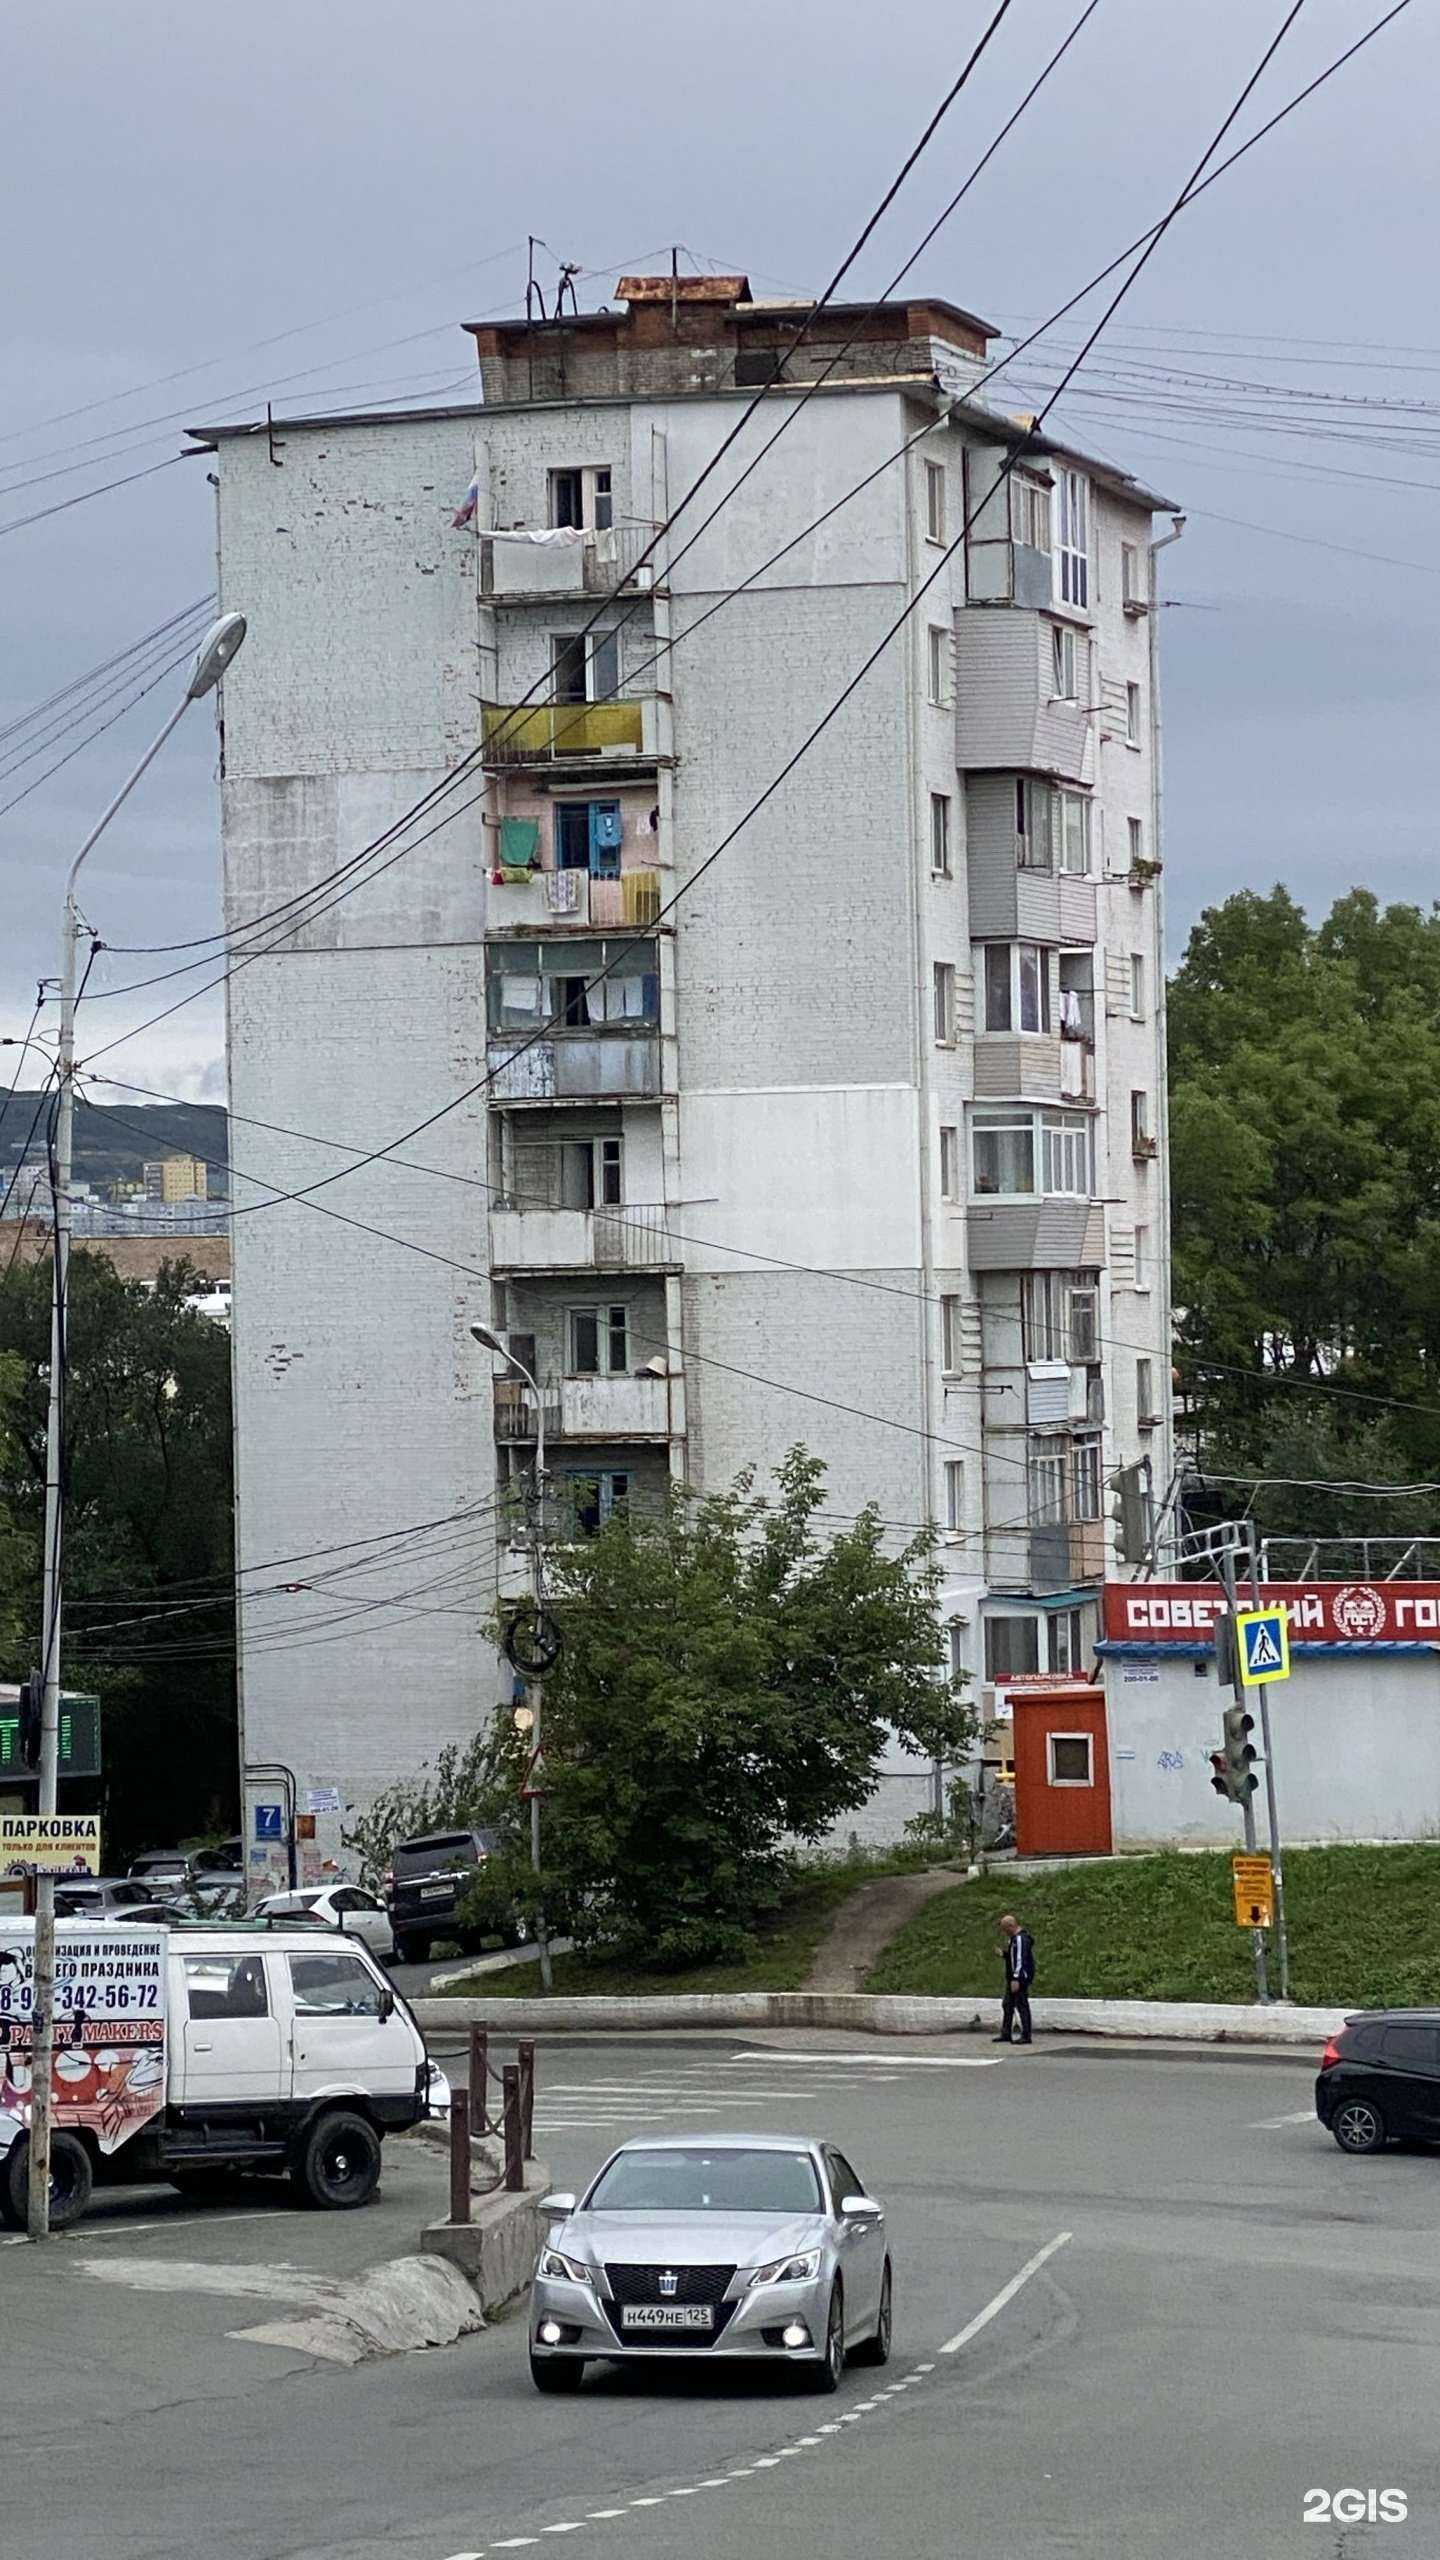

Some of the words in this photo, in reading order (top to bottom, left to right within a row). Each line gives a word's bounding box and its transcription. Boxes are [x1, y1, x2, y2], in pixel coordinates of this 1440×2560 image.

[1127, 1594, 1324, 1627] СОВЕТИЙ
[1395, 1600, 1440, 1627] ГО
[262, 1808, 275, 1827] 7
[2, 1820, 97, 1837] ПАРКОВКА
[2, 1843, 34, 1852] ТОЛЬКО
[36, 1843, 53, 1852] ДЛЯ
[26, 1945, 93, 1958] ОИЗАЦИЯ
[94, 1945, 100, 1956] И
[102, 1943, 161, 1957] ПРОВЕДЕНИЕ
[25, 1963, 77, 1978] ВЕГО
[81, 1962, 160, 1978] ПРАЗДНИКА
[0, 1985, 158, 2011] 8-9-342-56-72
[687, 2309, 709, 2321] 125
